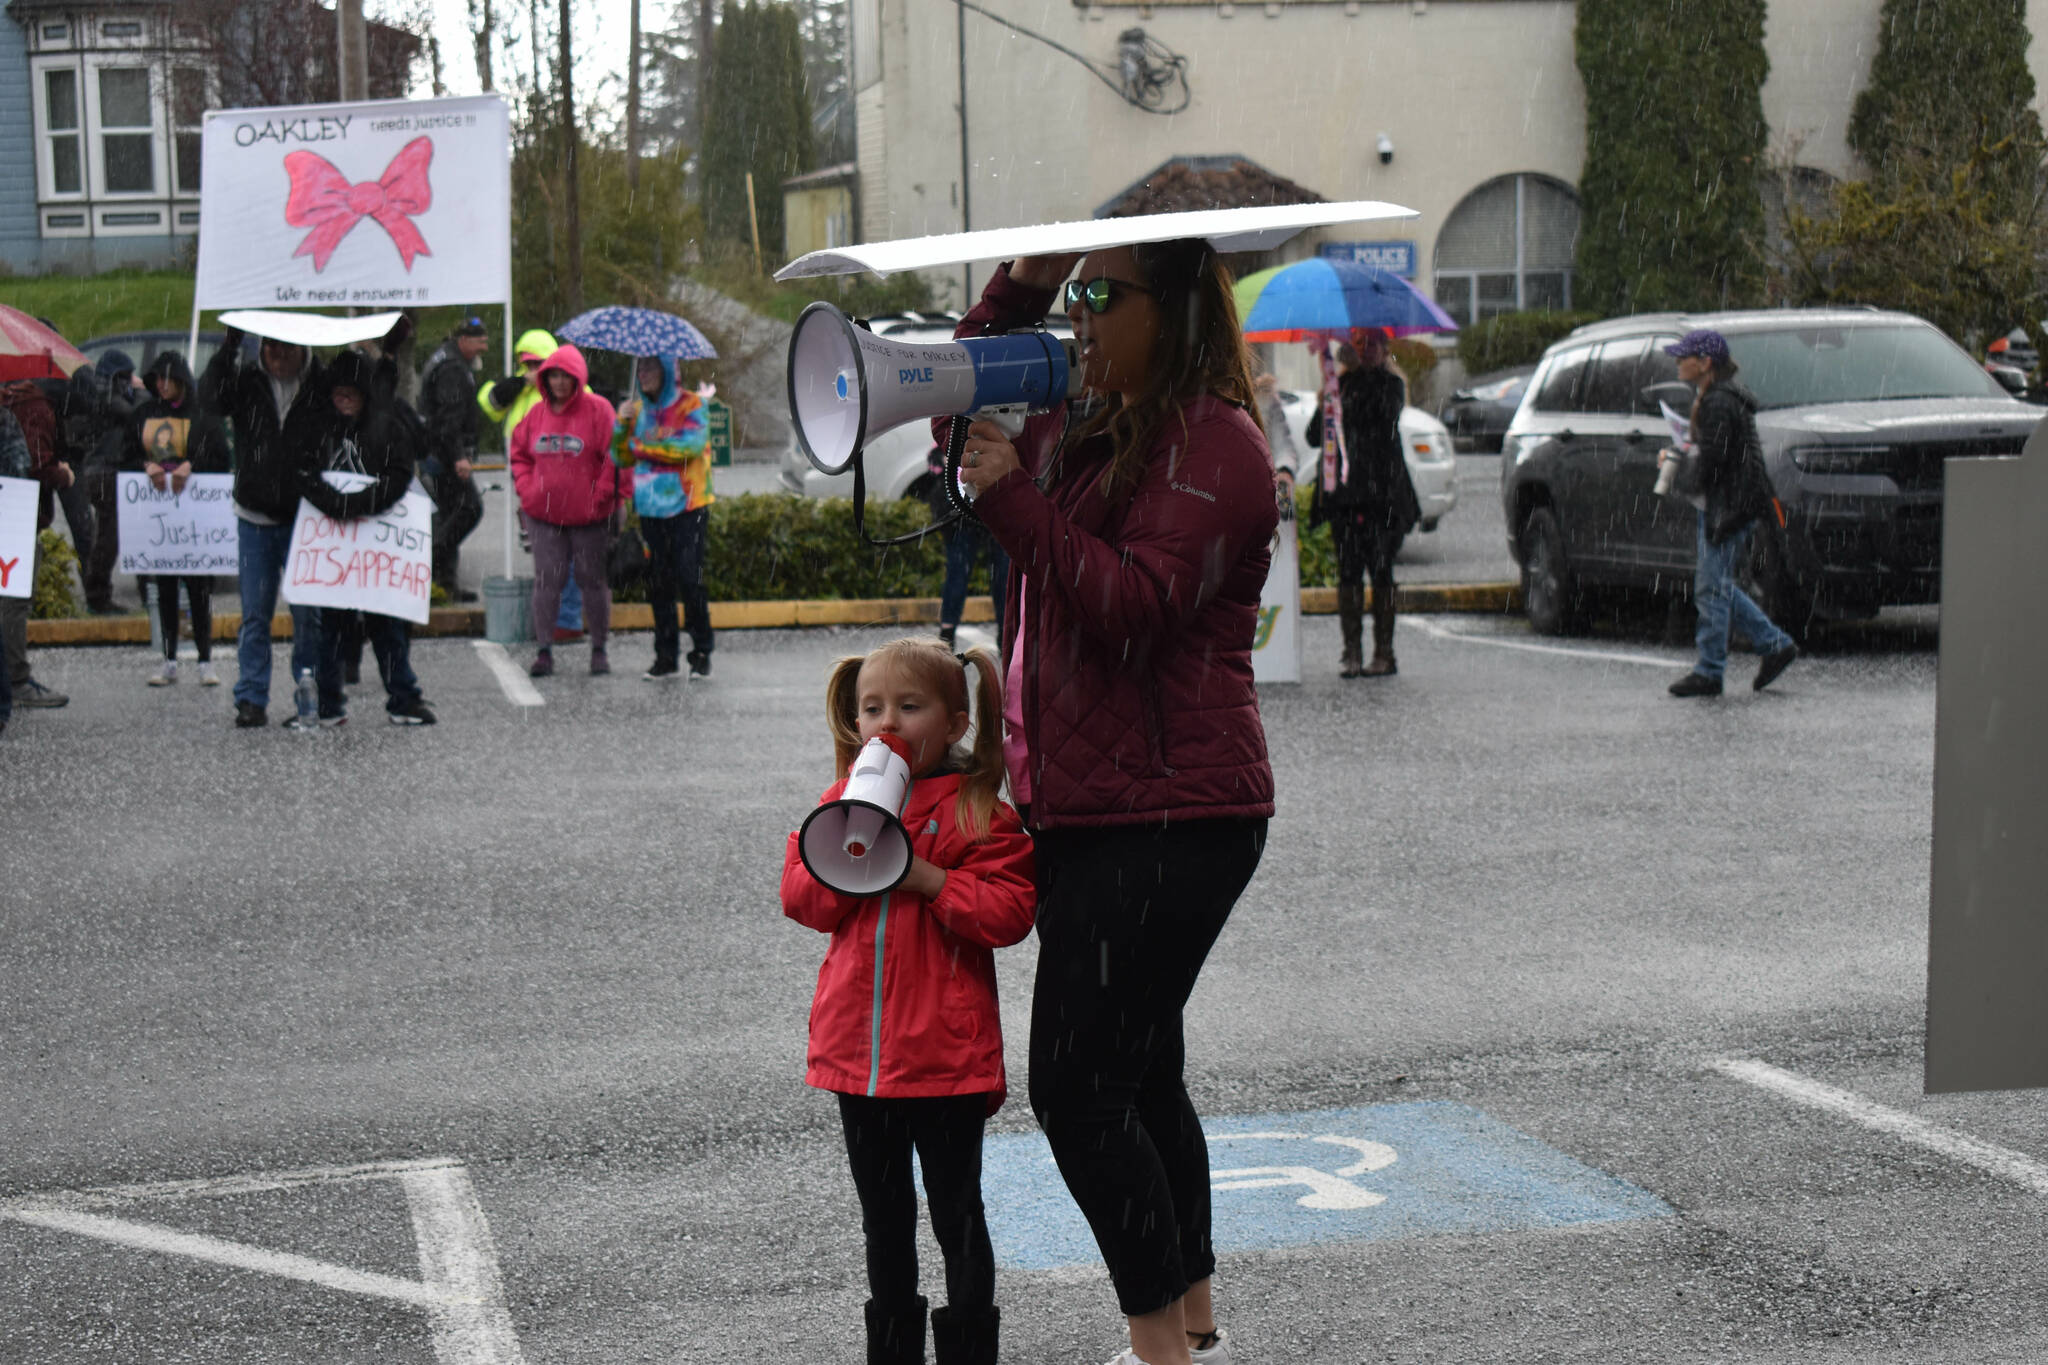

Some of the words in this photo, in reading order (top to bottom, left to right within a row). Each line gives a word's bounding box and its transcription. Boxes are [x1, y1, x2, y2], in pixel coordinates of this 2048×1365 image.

[235, 115, 352, 147] OAKLEY
[370, 117, 410, 131] needs
[413, 112, 463, 130] justice
[276, 286, 300, 301] We
[307, 287, 347, 301] need
[352, 287, 412, 300] answers
[923, 351, 966, 362] OAKLEY
[126, 479, 180, 508] Oakey
[1180, 483, 1216, 502] Columbia
[149, 513, 235, 546] Justice
[375, 520, 431, 552] JUST
[292, 546, 431, 599] DISAPPEAR
